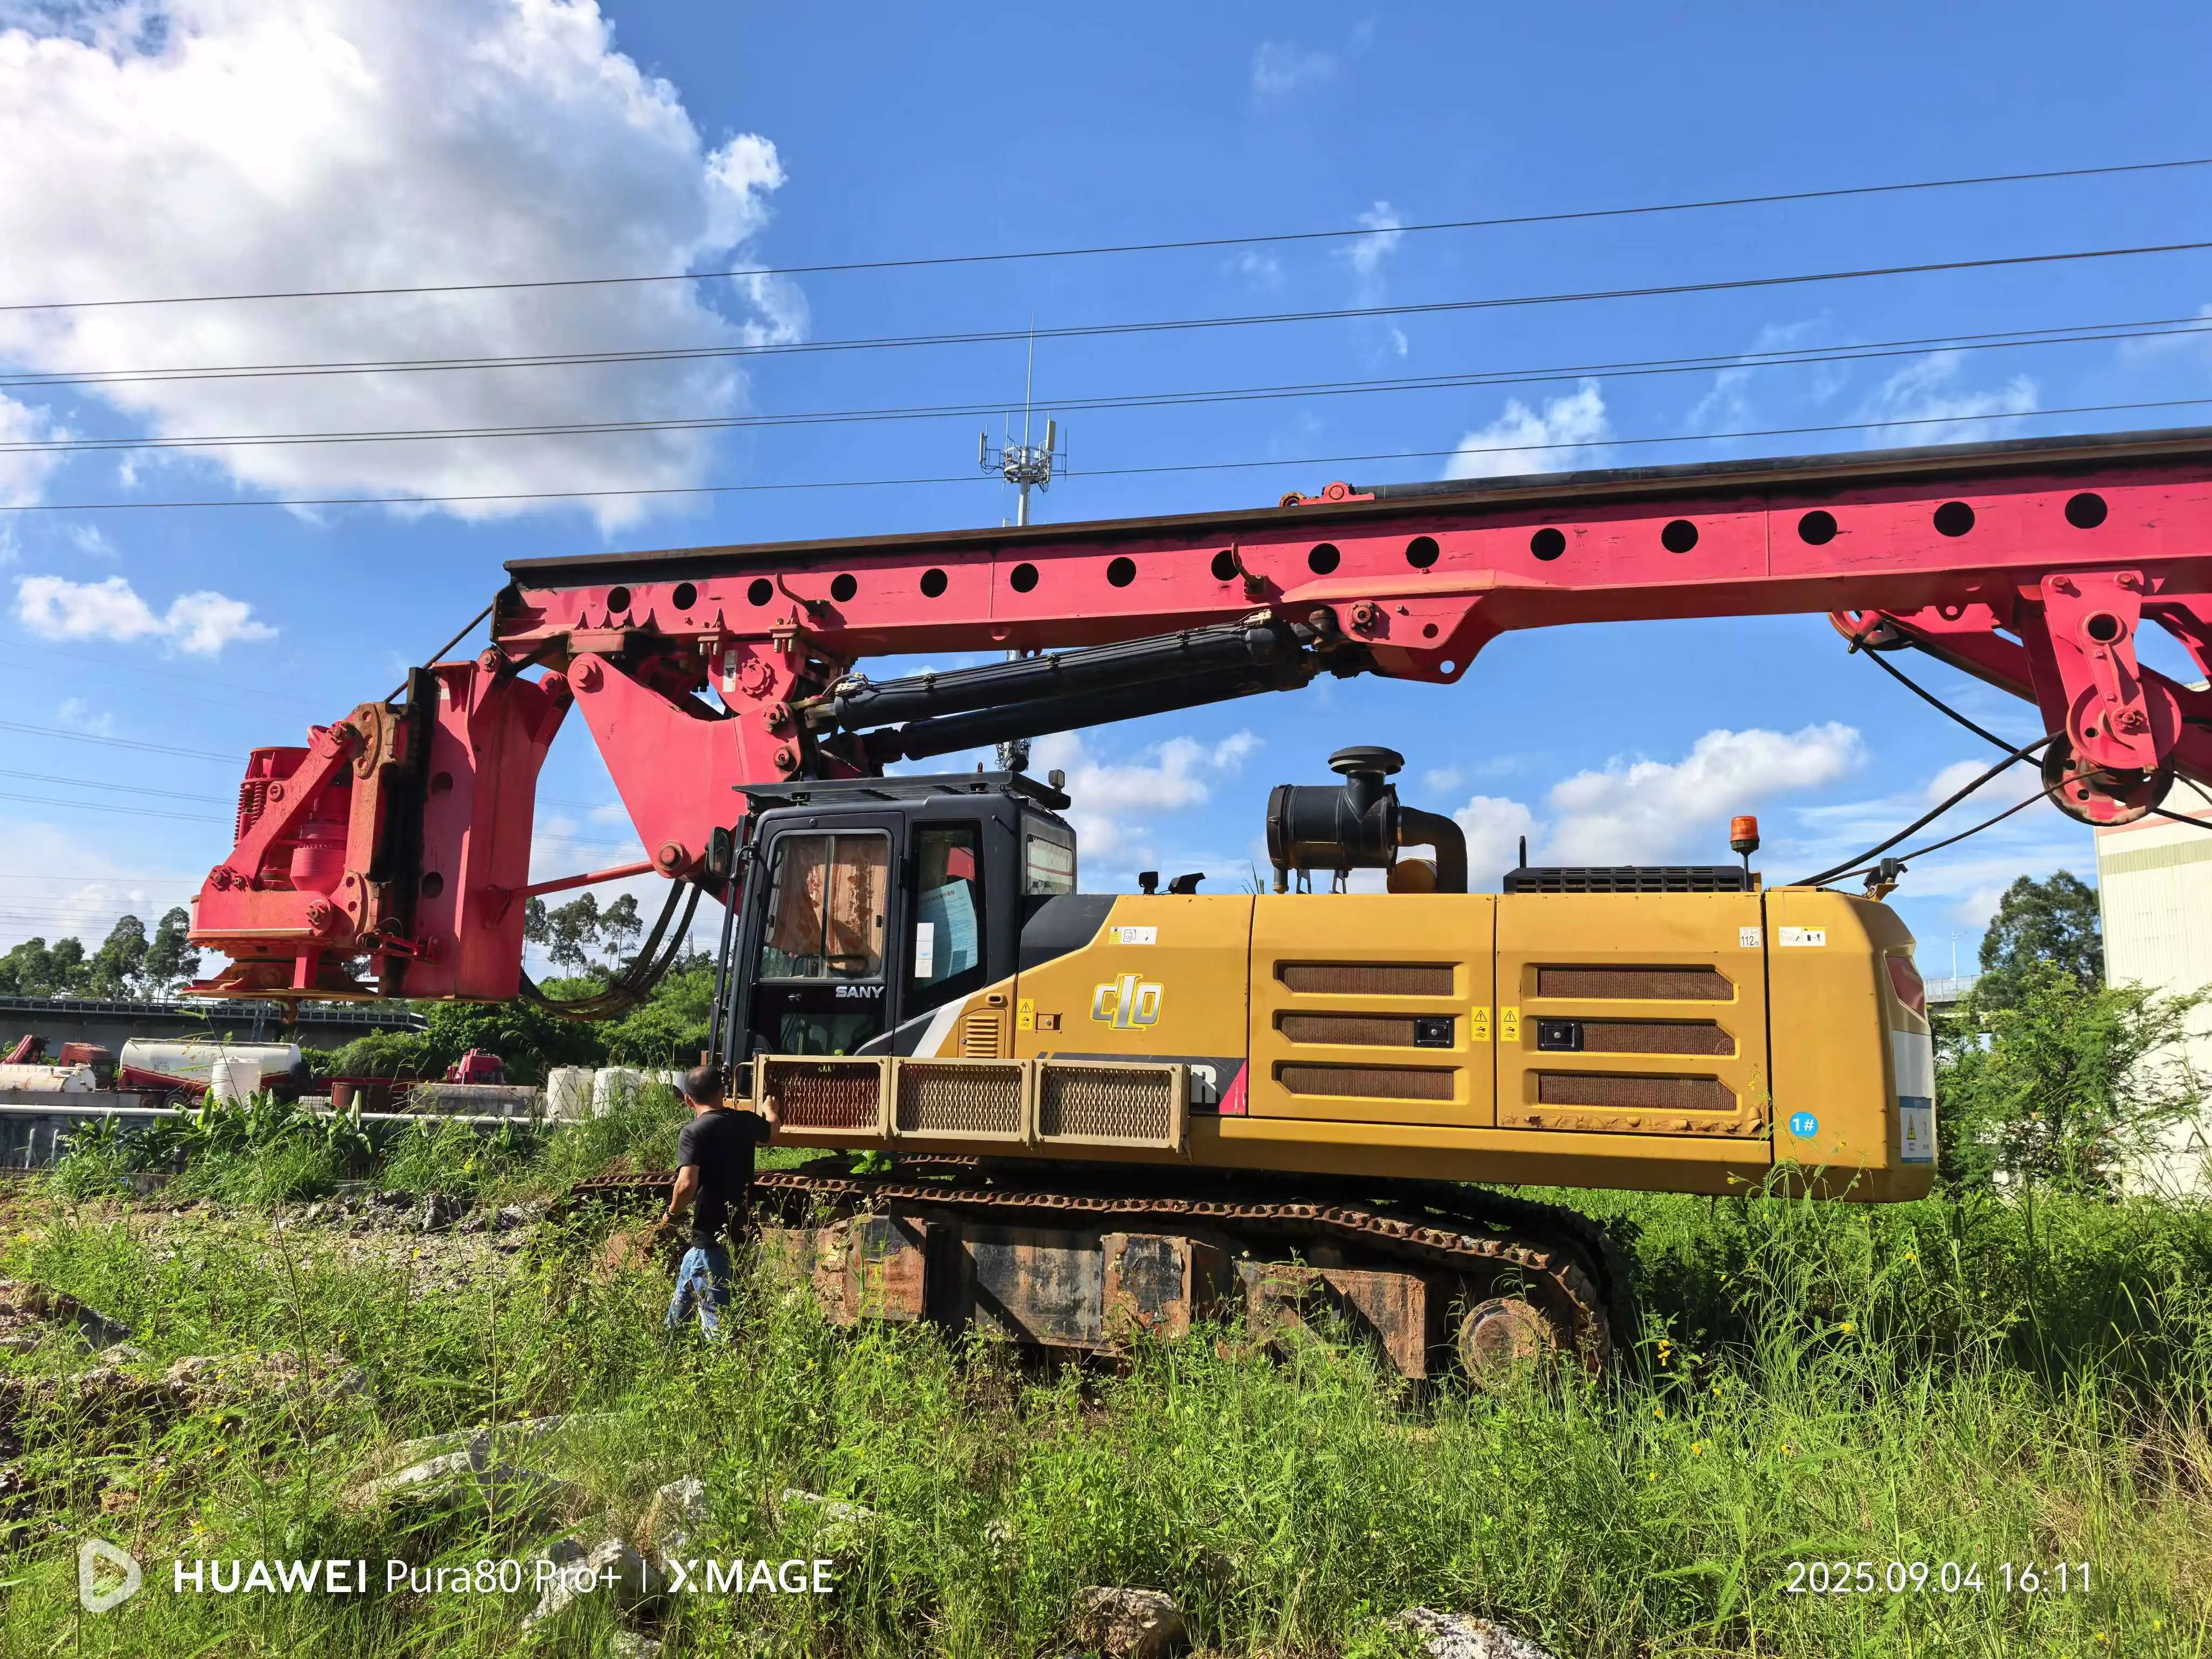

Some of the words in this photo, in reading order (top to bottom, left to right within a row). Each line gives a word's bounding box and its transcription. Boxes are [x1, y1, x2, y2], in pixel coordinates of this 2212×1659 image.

[1741, 935, 1754, 946] 112
[835, 986, 885, 998] SANY
[1792, 1117, 1815, 1132] 1#
